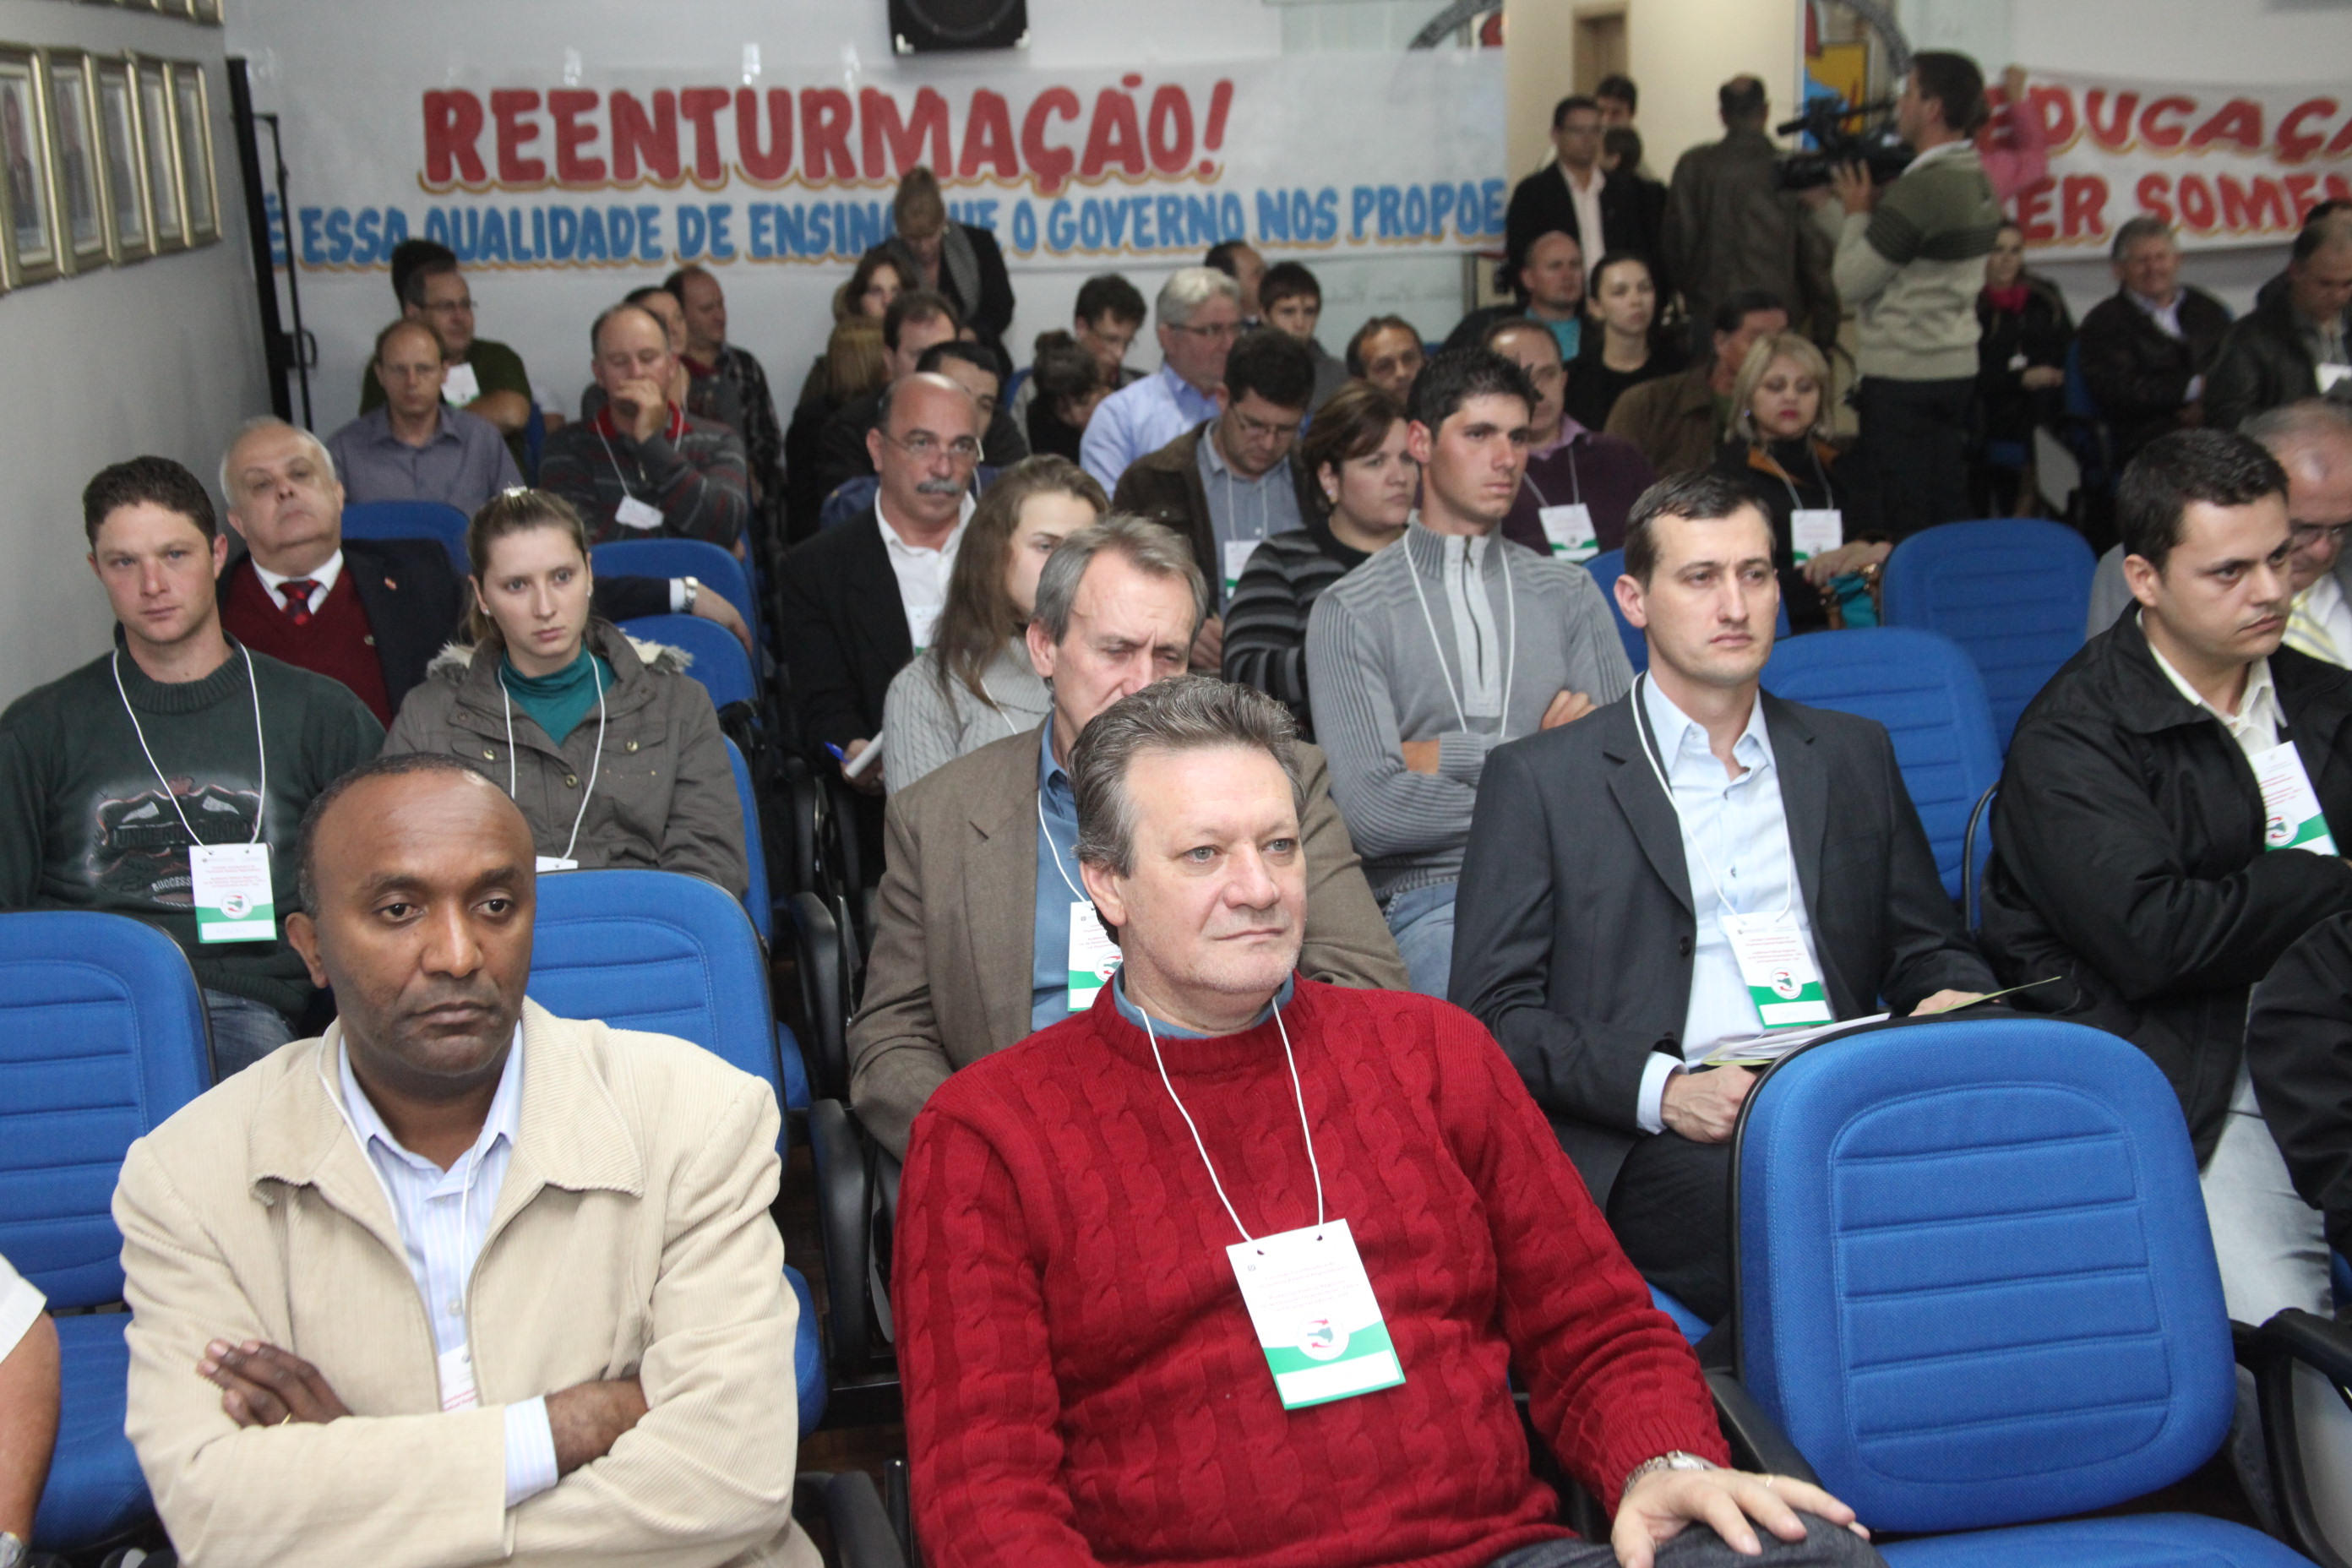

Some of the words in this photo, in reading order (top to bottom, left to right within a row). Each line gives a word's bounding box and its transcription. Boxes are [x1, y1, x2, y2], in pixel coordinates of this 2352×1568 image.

[422, 73, 1234, 192] REENTURMAÇÃO!
[299, 206, 409, 264] ESSA
[675, 204, 732, 259] DE
[1014, 199, 1037, 251] O
[1047, 192, 1245, 251] GOVERNO
[1258, 187, 1338, 242] NOS
[1352, 178, 1506, 238] PROPOE
